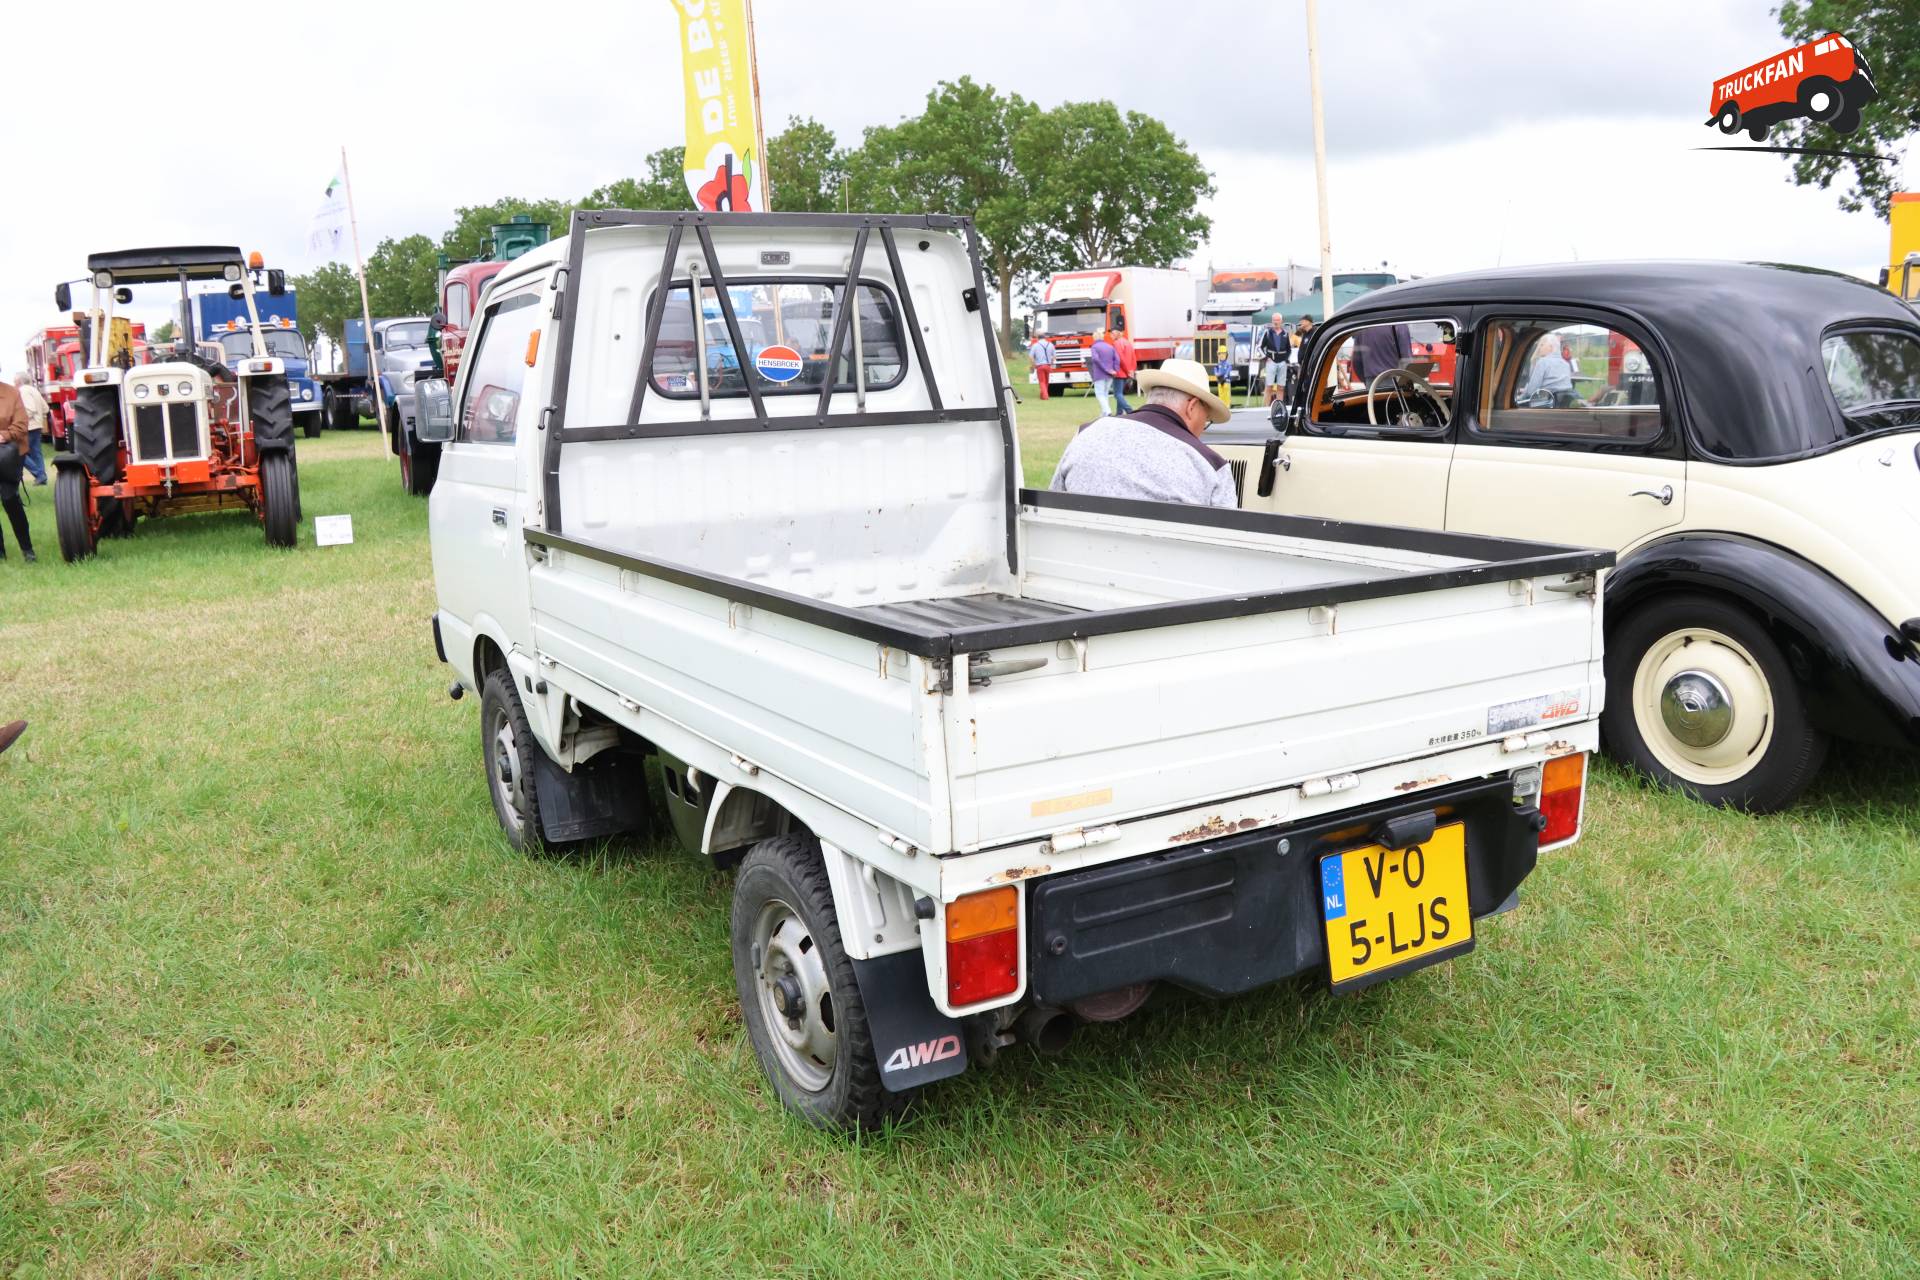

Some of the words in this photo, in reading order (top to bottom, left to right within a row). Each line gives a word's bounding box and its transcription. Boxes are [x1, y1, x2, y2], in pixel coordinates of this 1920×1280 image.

[695, 67, 724, 134] DE
[758, 359, 800, 368] HENSBROEK
[1326, 893, 1343, 909] NL
[1348, 896, 1451, 966] 5-LJS
[883, 1034, 961, 1073] 4WD
